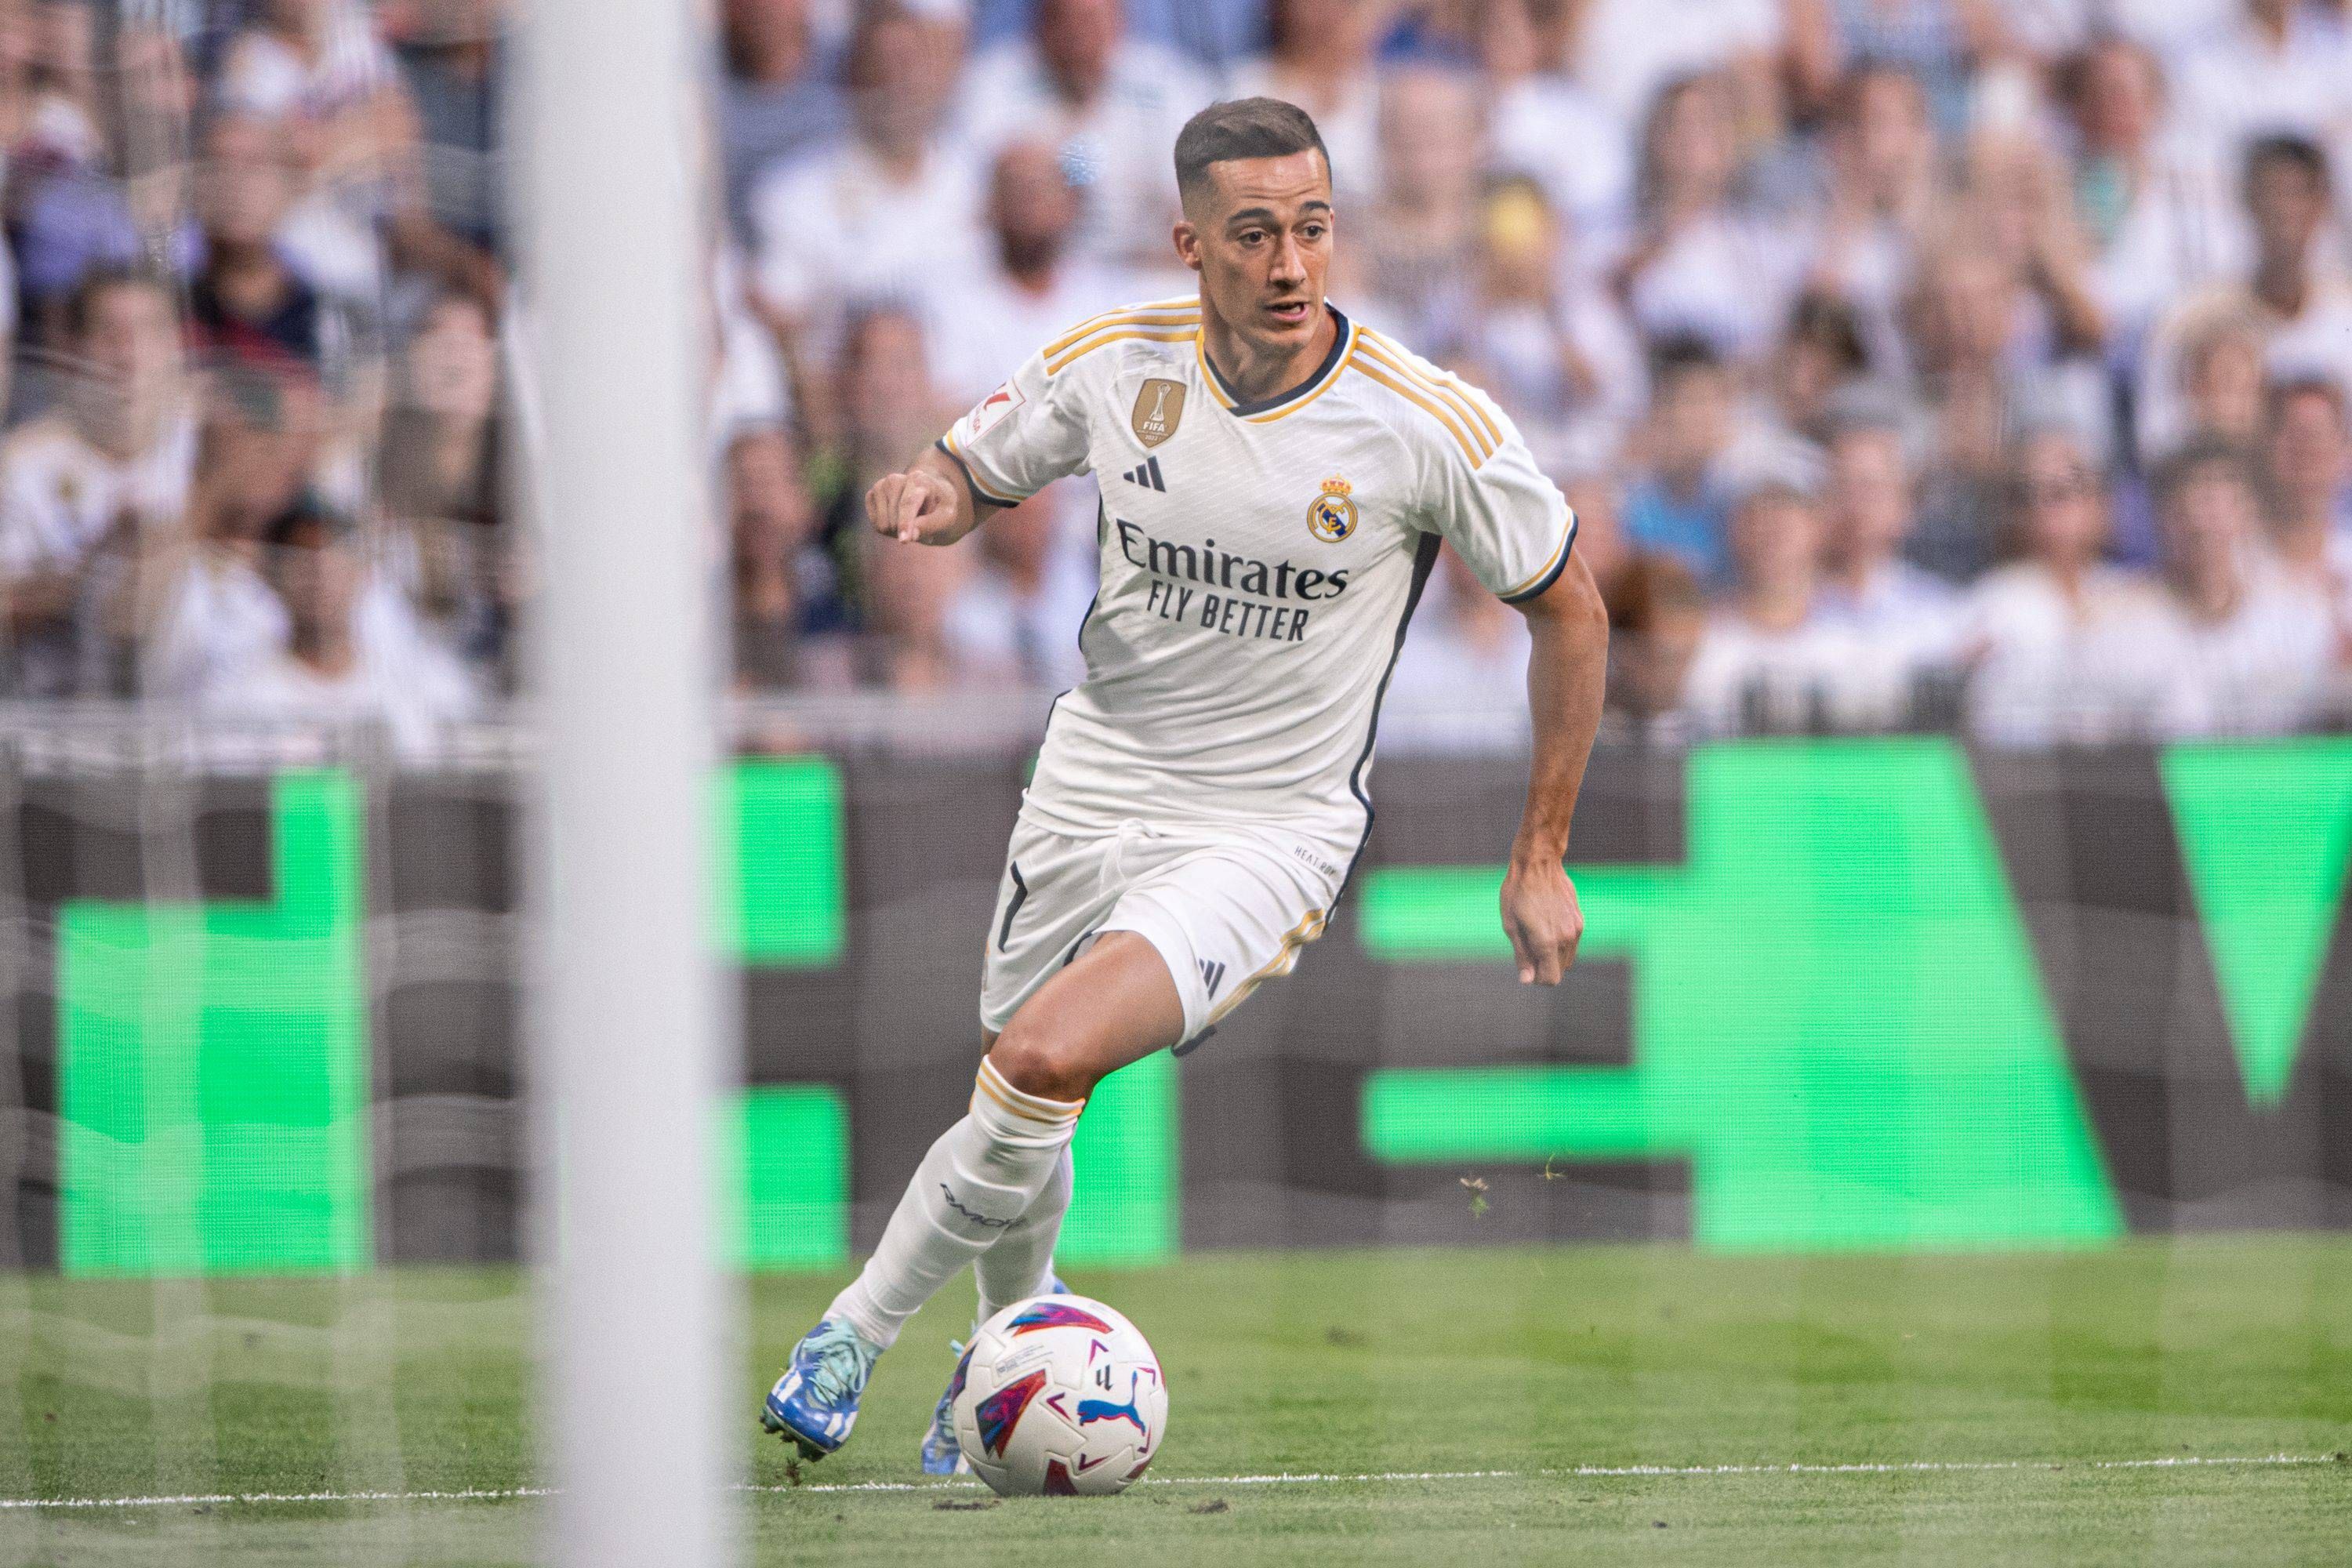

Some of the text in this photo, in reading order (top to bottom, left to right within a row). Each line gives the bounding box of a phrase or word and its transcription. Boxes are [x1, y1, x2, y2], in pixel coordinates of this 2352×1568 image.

[1143, 421, 1165, 432] FIFA
[1116, 518, 1348, 600] Emirates
[1146, 579, 1309, 641] FLY BETTER
